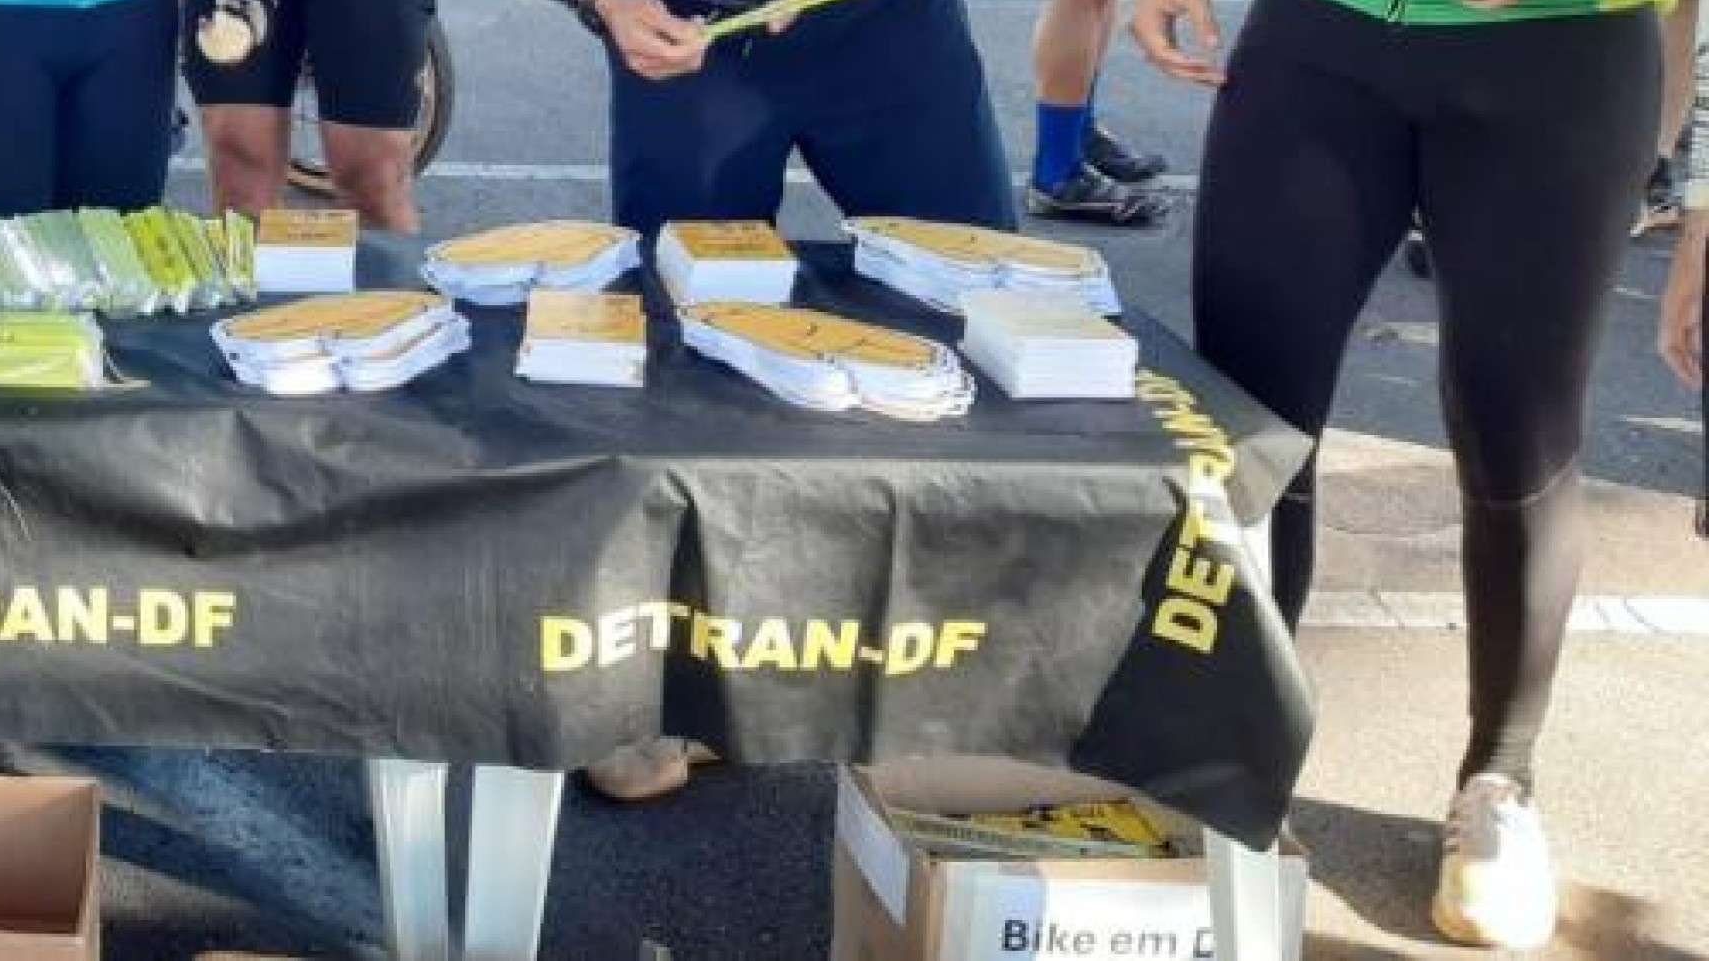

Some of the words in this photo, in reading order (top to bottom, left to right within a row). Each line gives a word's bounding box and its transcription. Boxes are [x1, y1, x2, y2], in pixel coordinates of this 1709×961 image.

[539, 600, 988, 676] DETRAN-DF
[1003, 918, 1096, 955] Bike
[1110, 929, 1177, 955] em
